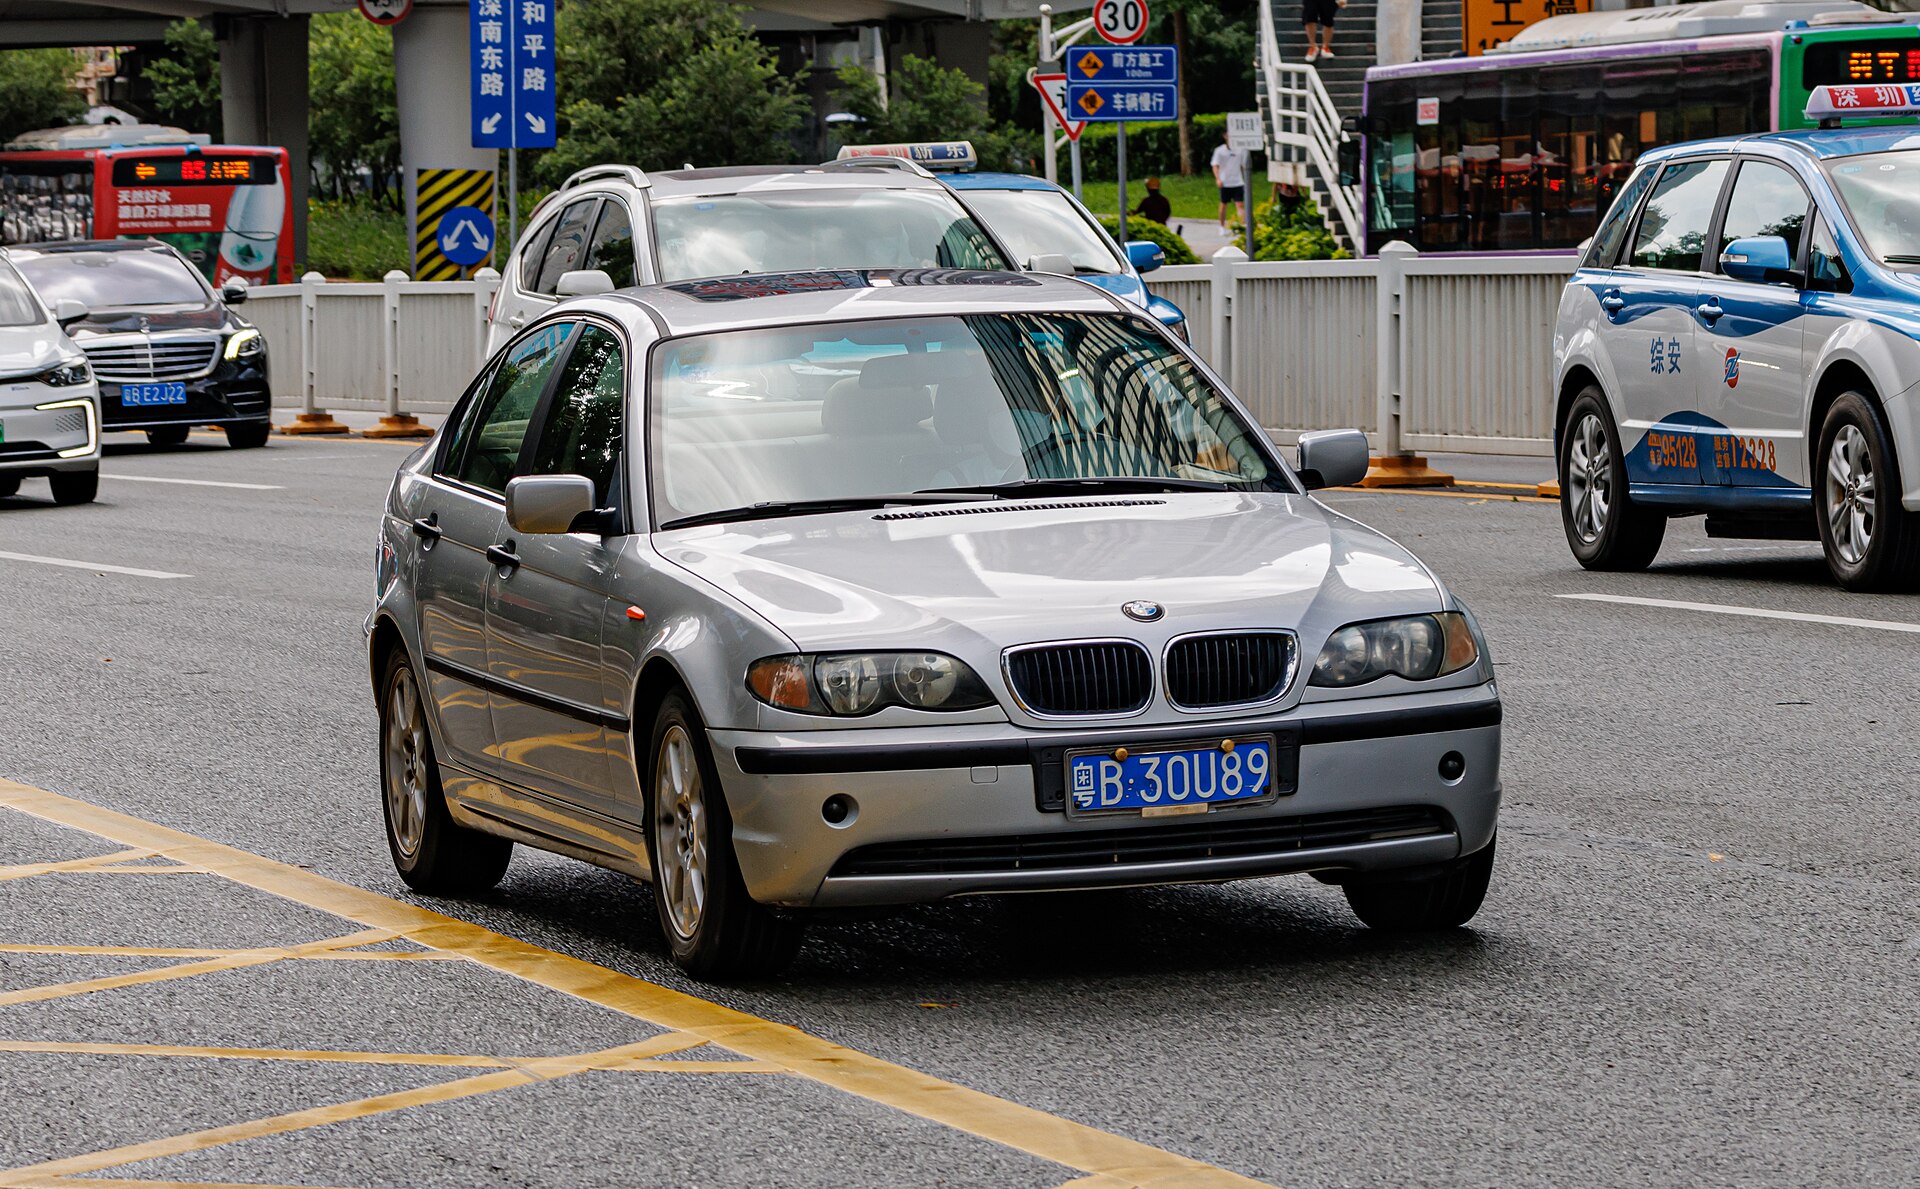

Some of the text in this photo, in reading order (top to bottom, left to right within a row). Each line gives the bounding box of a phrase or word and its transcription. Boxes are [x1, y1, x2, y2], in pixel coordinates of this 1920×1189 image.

[1103, 1, 1139, 32] 30
[478, 0, 504, 97] 深南东路
[522, 1, 547, 92] 和平路
[1112, 52, 1164, 68] 前方施工
[1112, 92, 1165, 112] 车辆慢行
[1833, 87, 1901, 107] 深圳
[1650, 336, 1681, 375] 综安
[1661, 434, 1697, 469] 95128
[1730, 437, 1777, 473] 12328
